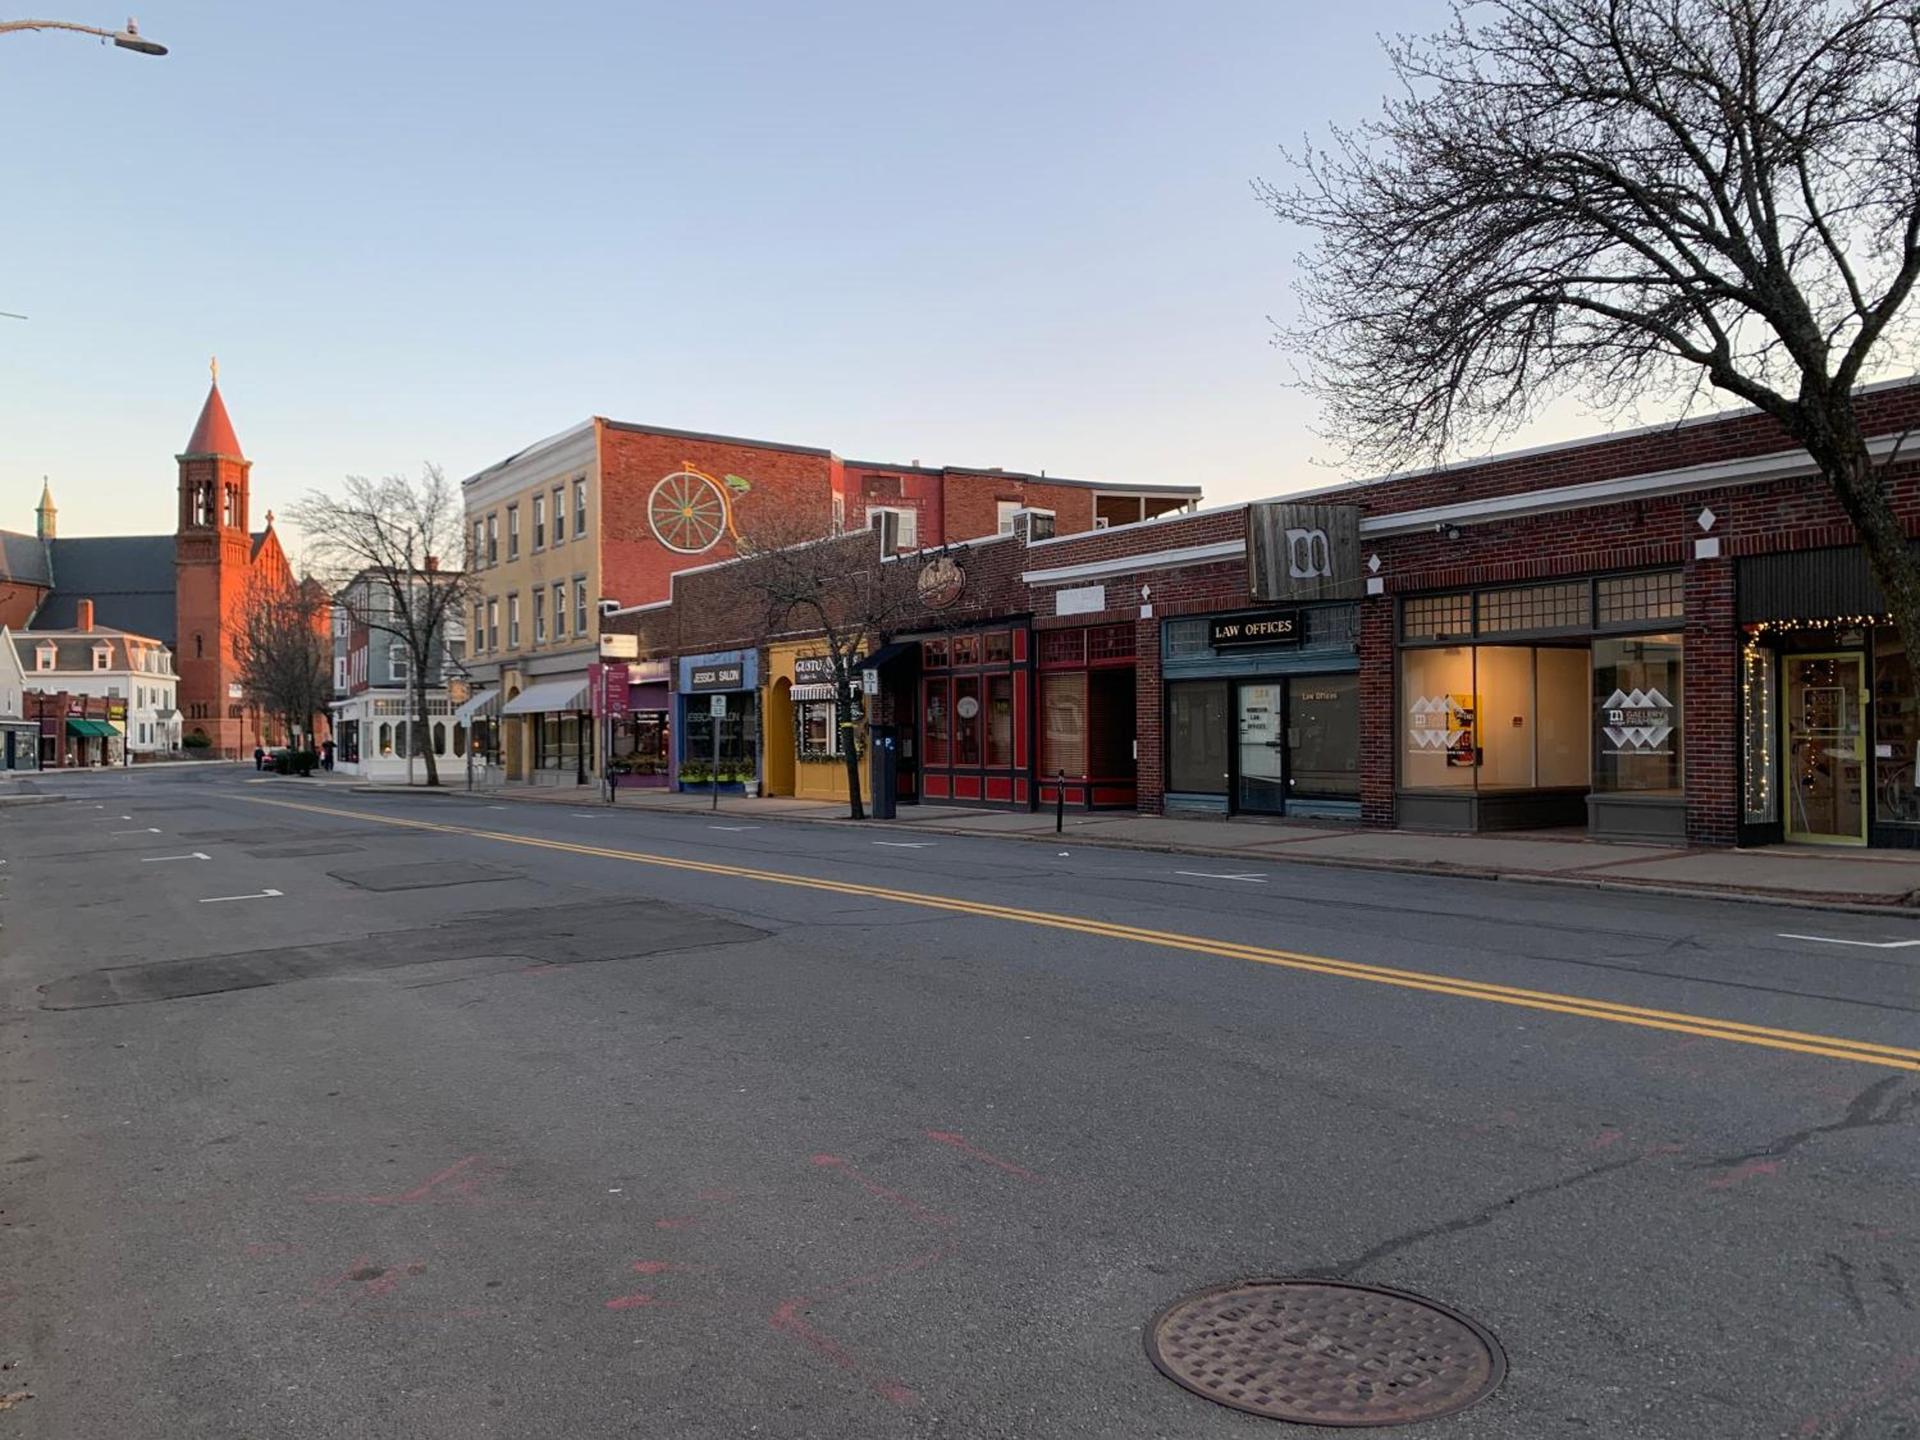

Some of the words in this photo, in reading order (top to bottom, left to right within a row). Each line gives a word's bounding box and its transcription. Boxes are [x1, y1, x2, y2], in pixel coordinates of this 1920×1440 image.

[1215, 625, 1240, 638] LAW
[1245, 619, 1292, 636] OFFICES
[693, 671, 716, 684] JESSICA
[718, 669, 739, 682] SALON
